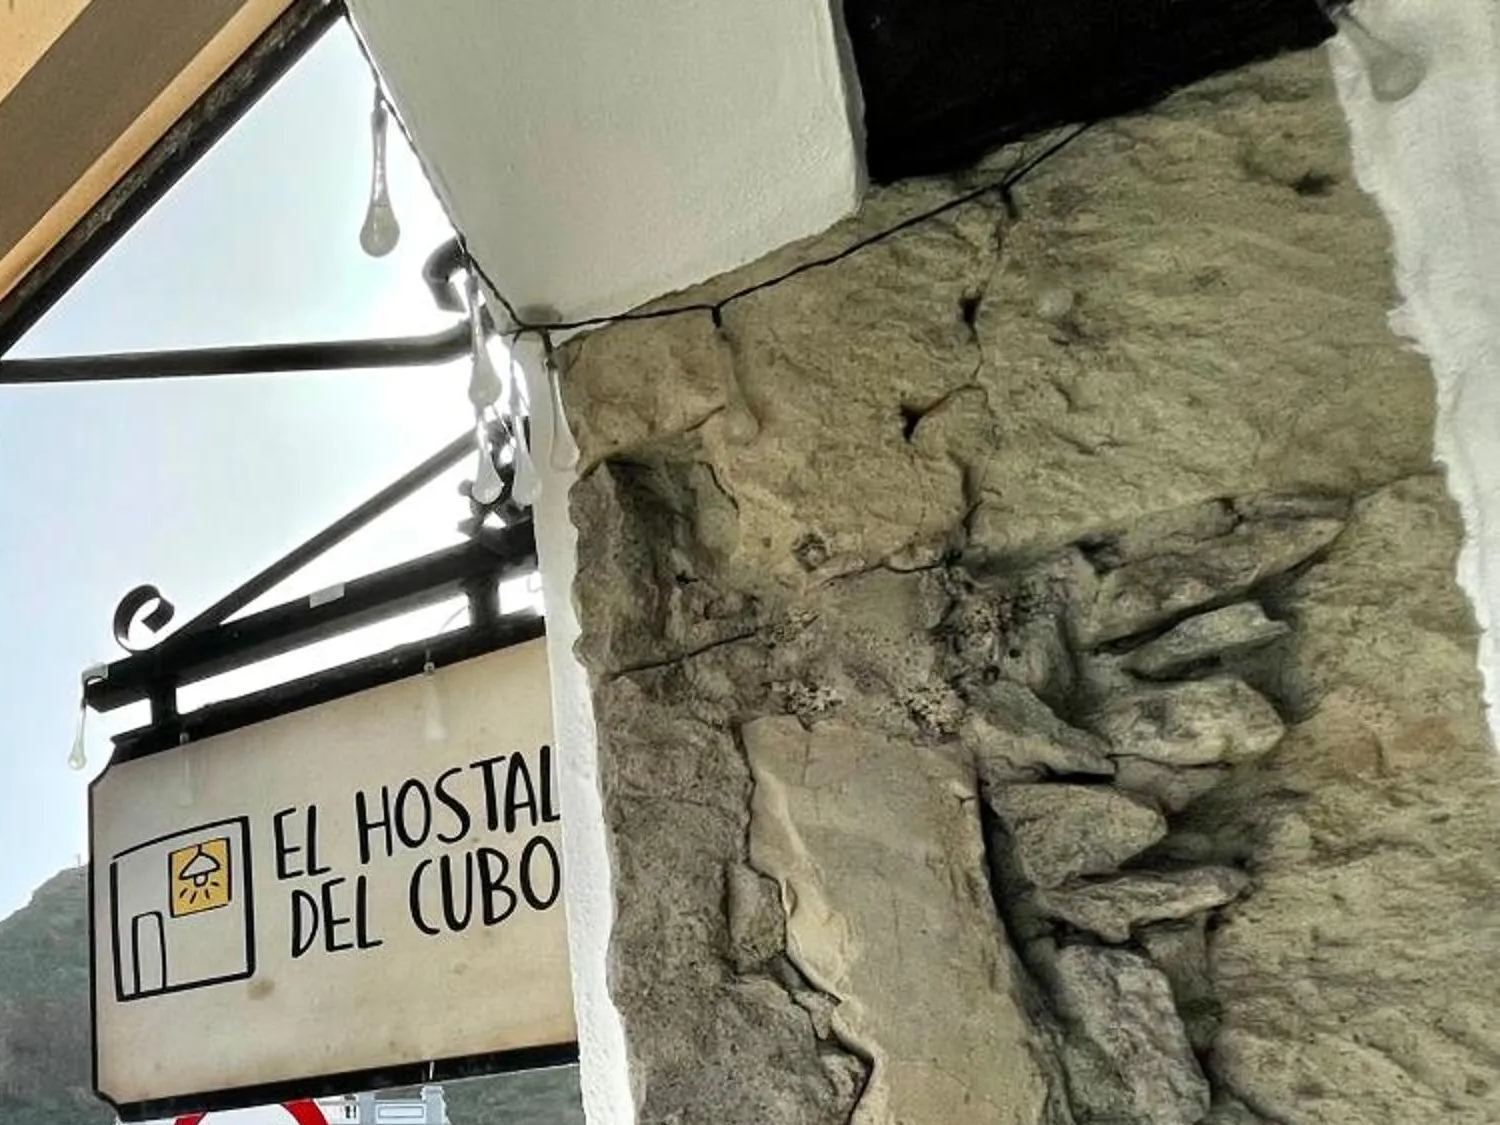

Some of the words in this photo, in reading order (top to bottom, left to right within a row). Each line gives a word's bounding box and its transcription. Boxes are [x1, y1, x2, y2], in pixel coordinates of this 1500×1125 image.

[273, 805, 331, 881] EL
[355, 745, 561, 865] HOSTAL
[291, 876, 384, 959] DEL
[409, 835, 562, 936] CUBO
